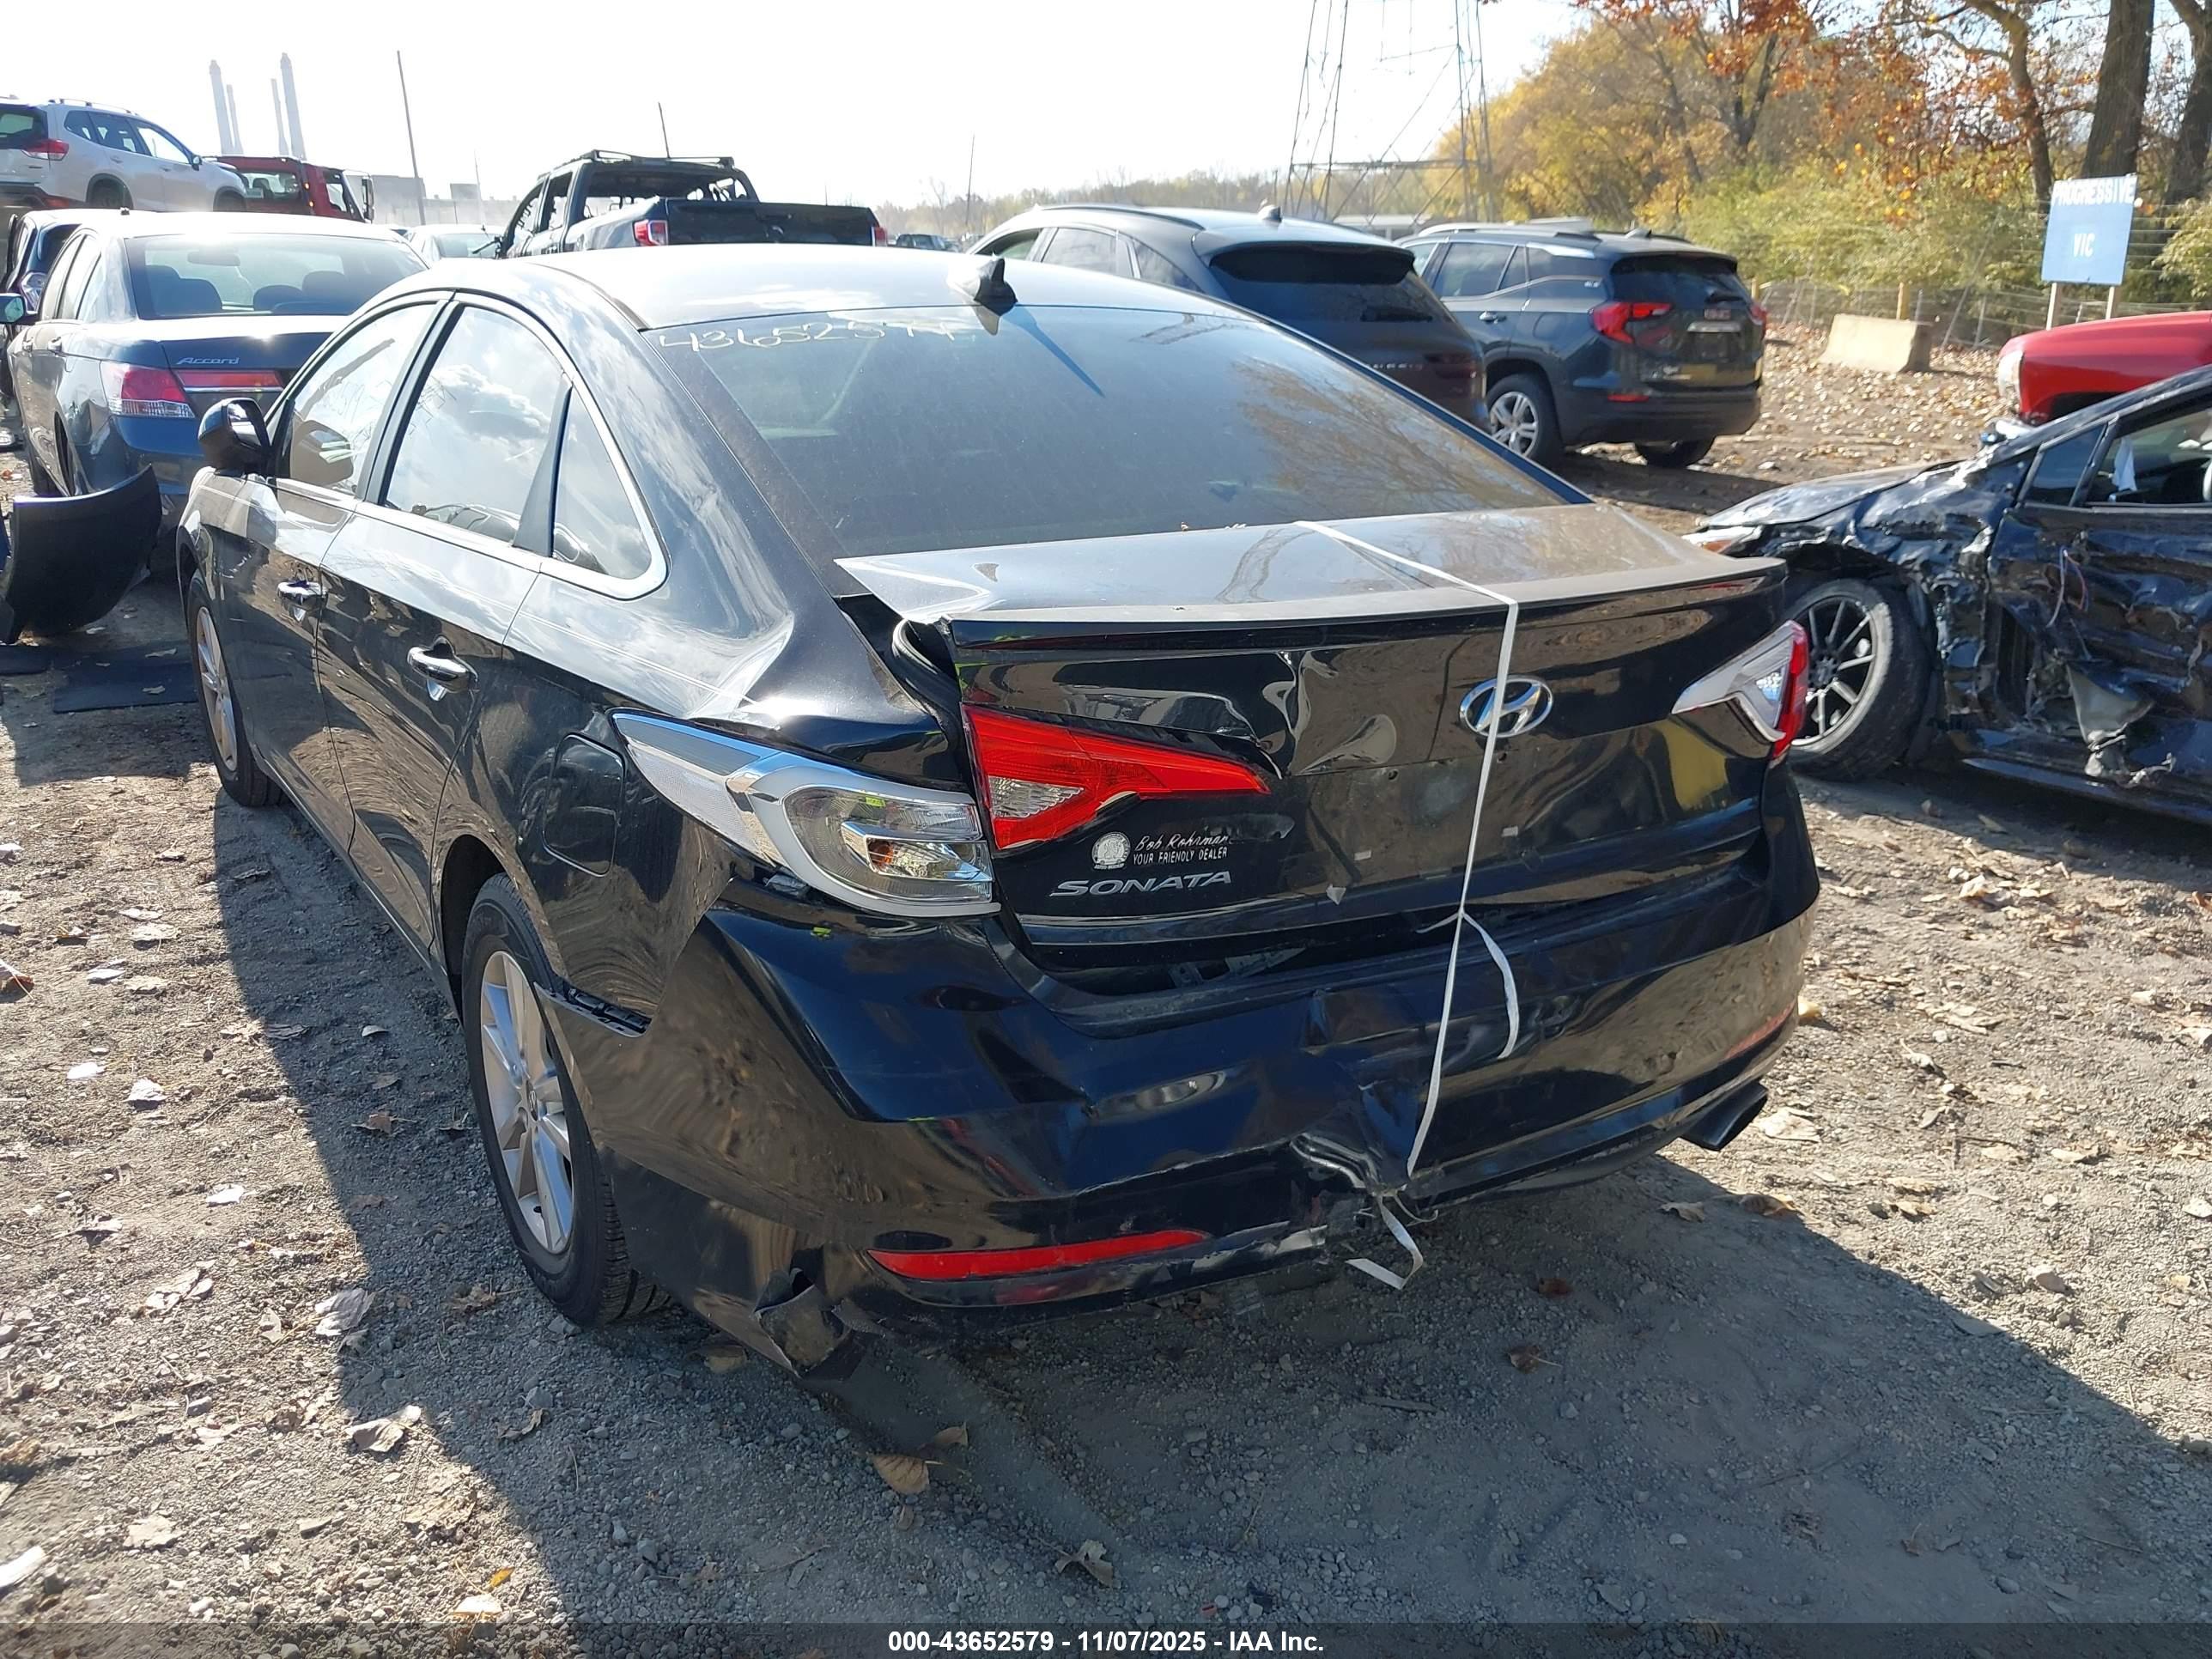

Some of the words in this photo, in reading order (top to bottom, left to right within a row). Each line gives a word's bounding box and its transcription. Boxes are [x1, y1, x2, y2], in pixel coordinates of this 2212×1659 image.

[2051, 177, 2135, 206] PROGRESSIVE
[2073, 233, 2095, 257] VIC
[176, 356, 240, 365] Accord
[1134, 834, 1164, 851] Bob
[1133, 853, 1154, 866] YOUR
[1158, 849, 1194, 864] FRIENDLY
[1198, 846, 1228, 860] DEALER
[1049, 871, 1231, 896] SONATA
